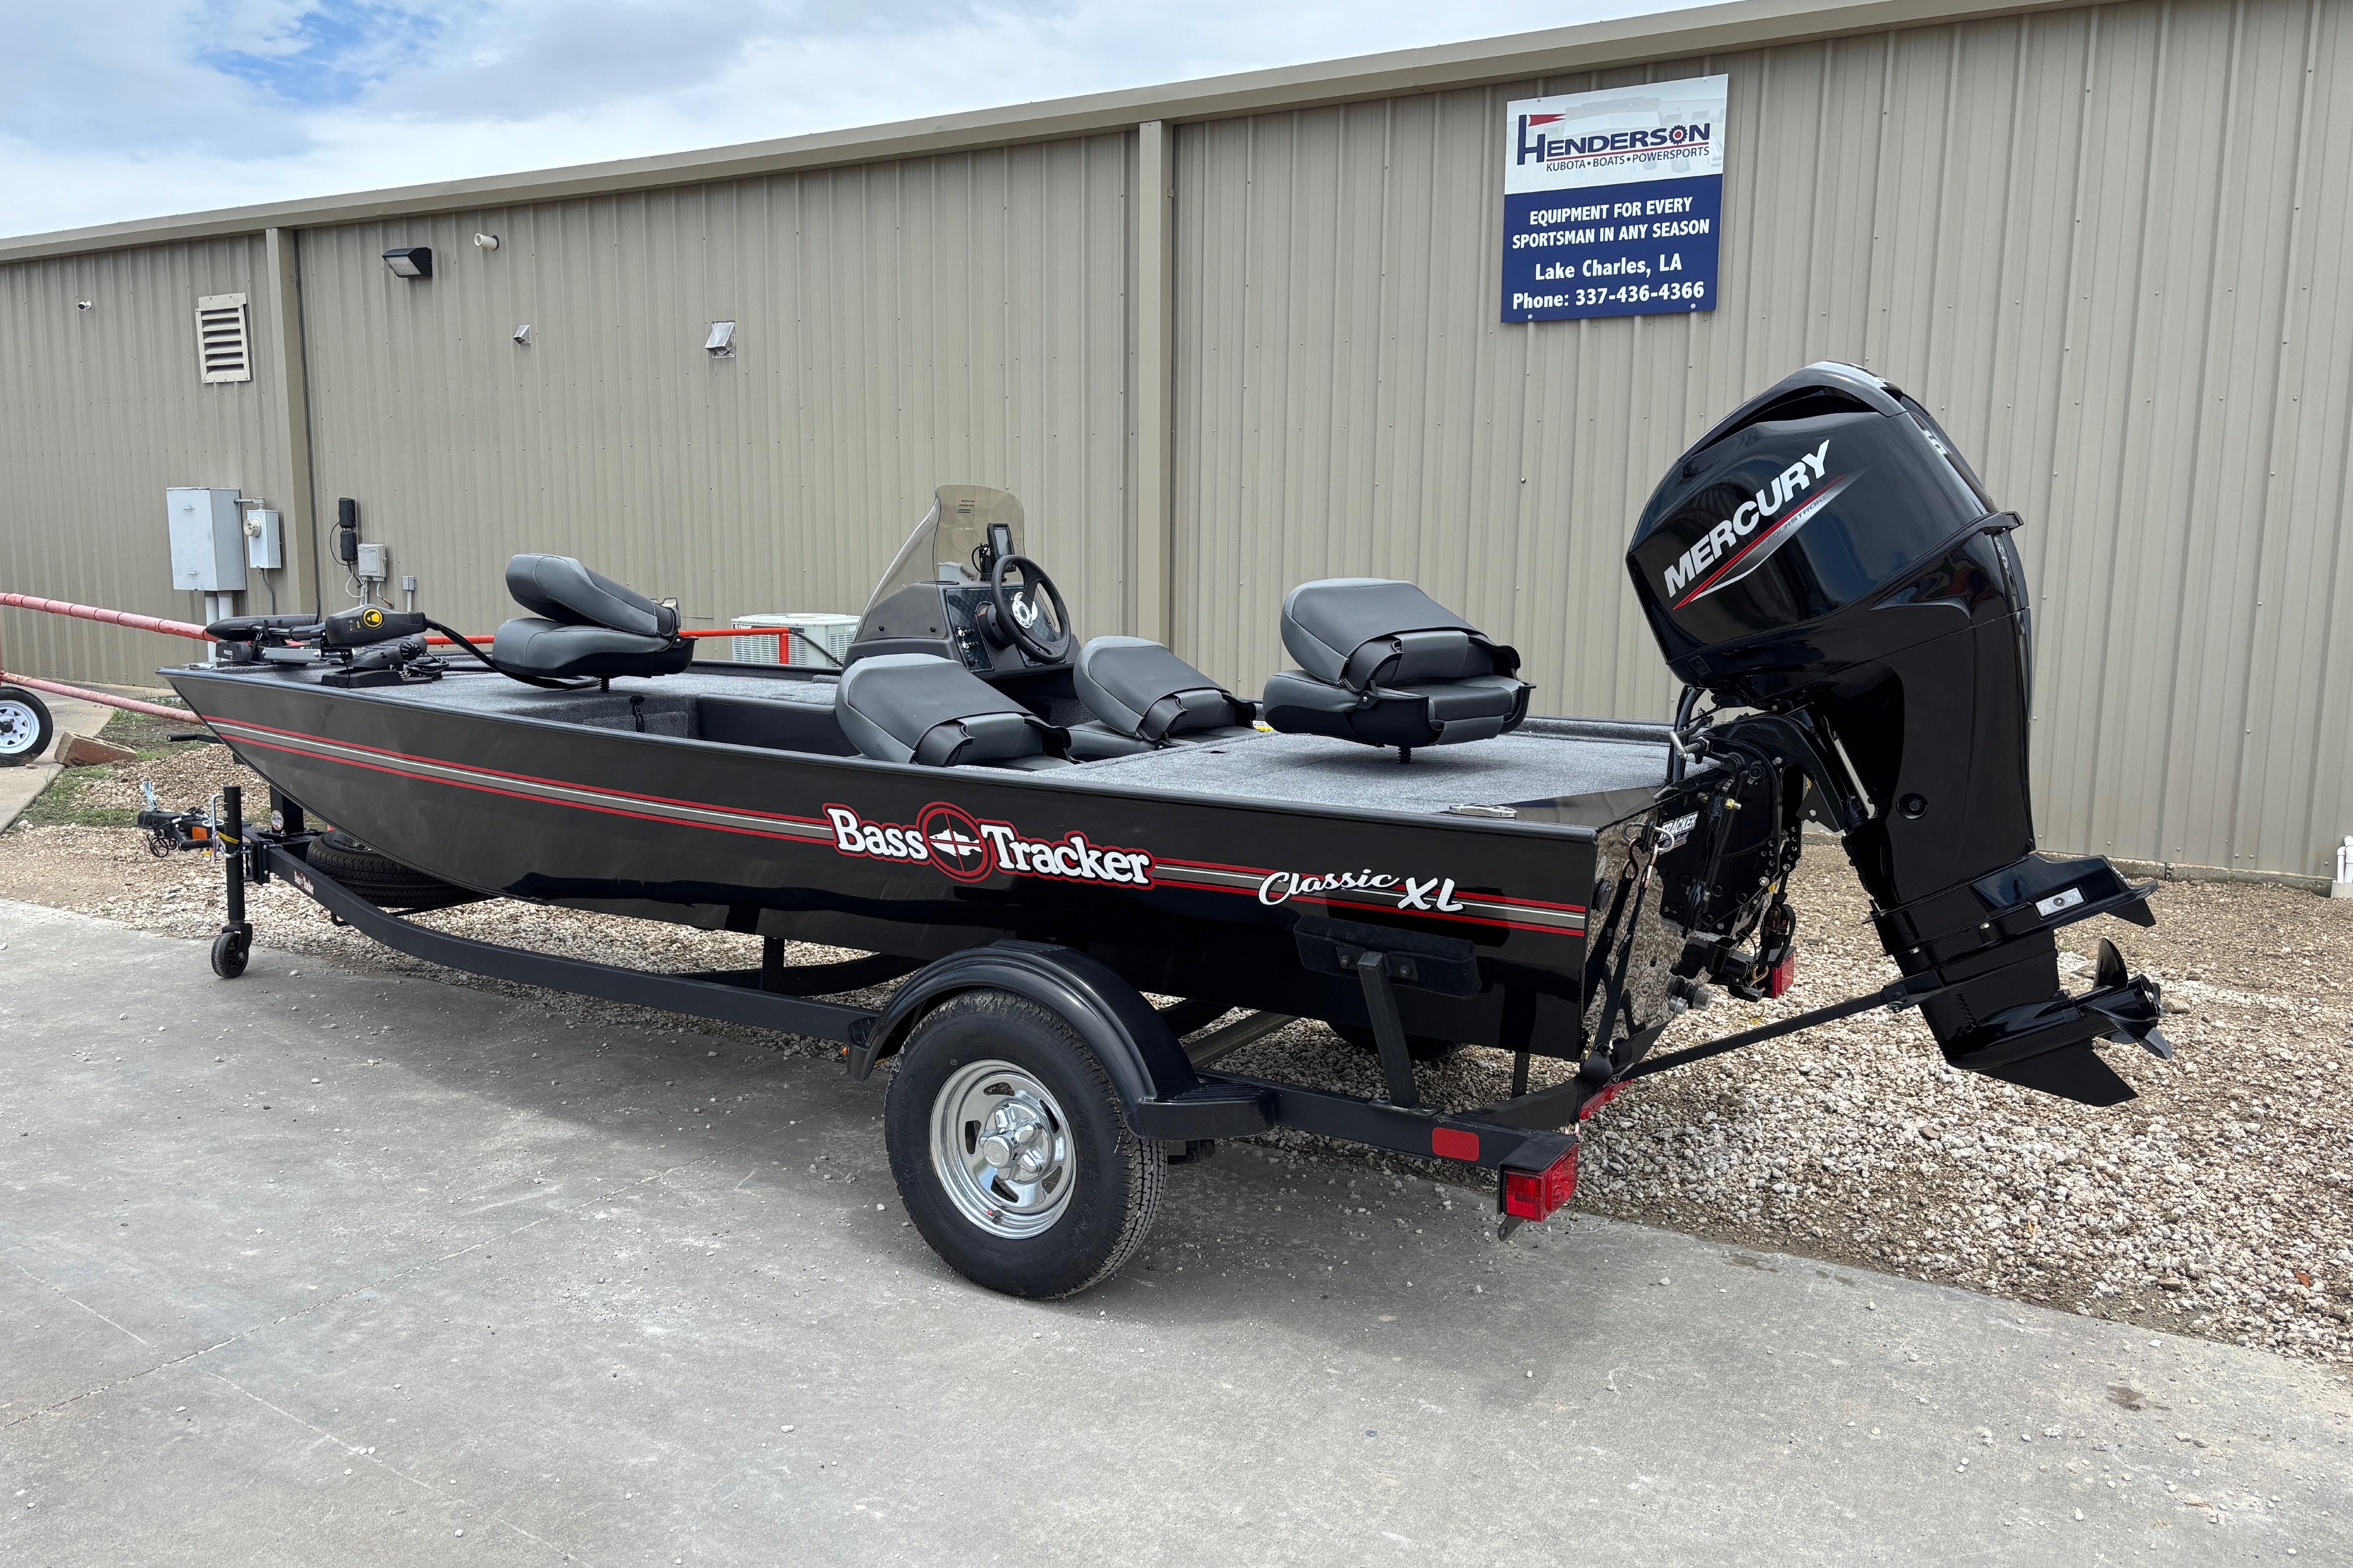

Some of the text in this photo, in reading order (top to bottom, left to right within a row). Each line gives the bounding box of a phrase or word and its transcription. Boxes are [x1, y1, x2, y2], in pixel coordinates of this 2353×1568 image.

[1517, 114, 1711, 166] HENDERSON
[1546, 146, 1710, 172] KUBOTA BOATS POWERSPORTS
[1530, 196, 1693, 227] EQUIPMENT FOR EVERY
[1512, 218, 1710, 249] SPORTSMAN IN ANY SEASON
[1535, 253, 1682, 281] Lake Charles, LA
[1513, 281, 1704, 310] Phone: 337-436-4366
[1663, 439, 1830, 598] MERCURY
[1766, 491, 1829, 544] FOURSTROKE
[827, 807, 1151, 884] Bass Tracker
[1258, 868, 1464, 912] Classic XL
